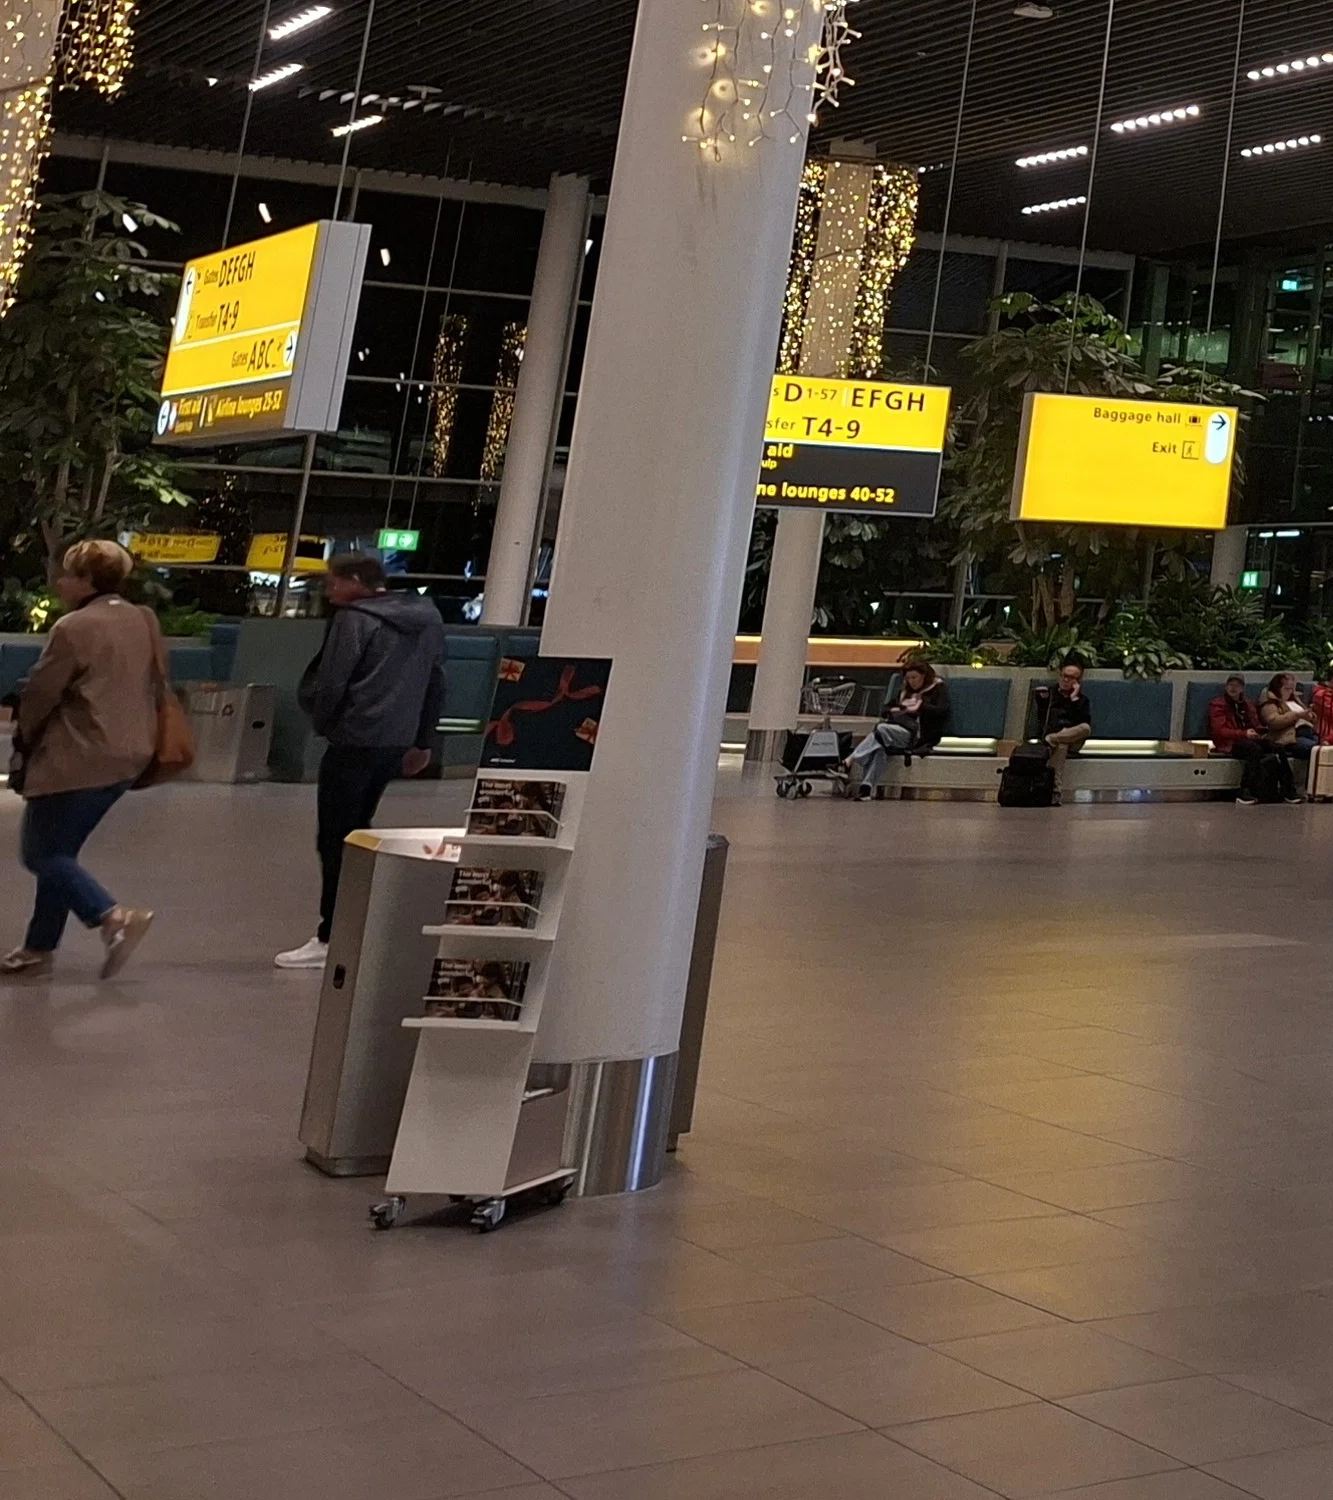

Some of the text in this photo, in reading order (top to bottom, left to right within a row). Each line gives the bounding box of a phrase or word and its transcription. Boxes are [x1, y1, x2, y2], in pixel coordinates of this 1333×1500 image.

[218, 251, 256, 288] DEFGH
[247, 338, 275, 372] ABC
[785, 383, 803, 402] D
[807, 388, 838, 401] 1-57
[1094, 407, 1181, 424] Baggage hall
[802, 416, 860, 439] T4-9
[767, 443, 793, 458] aid
[1152, 441, 1177, 454] Exit
[782, 482, 846, 502] lounges
[851, 487, 894, 503] 40-52
